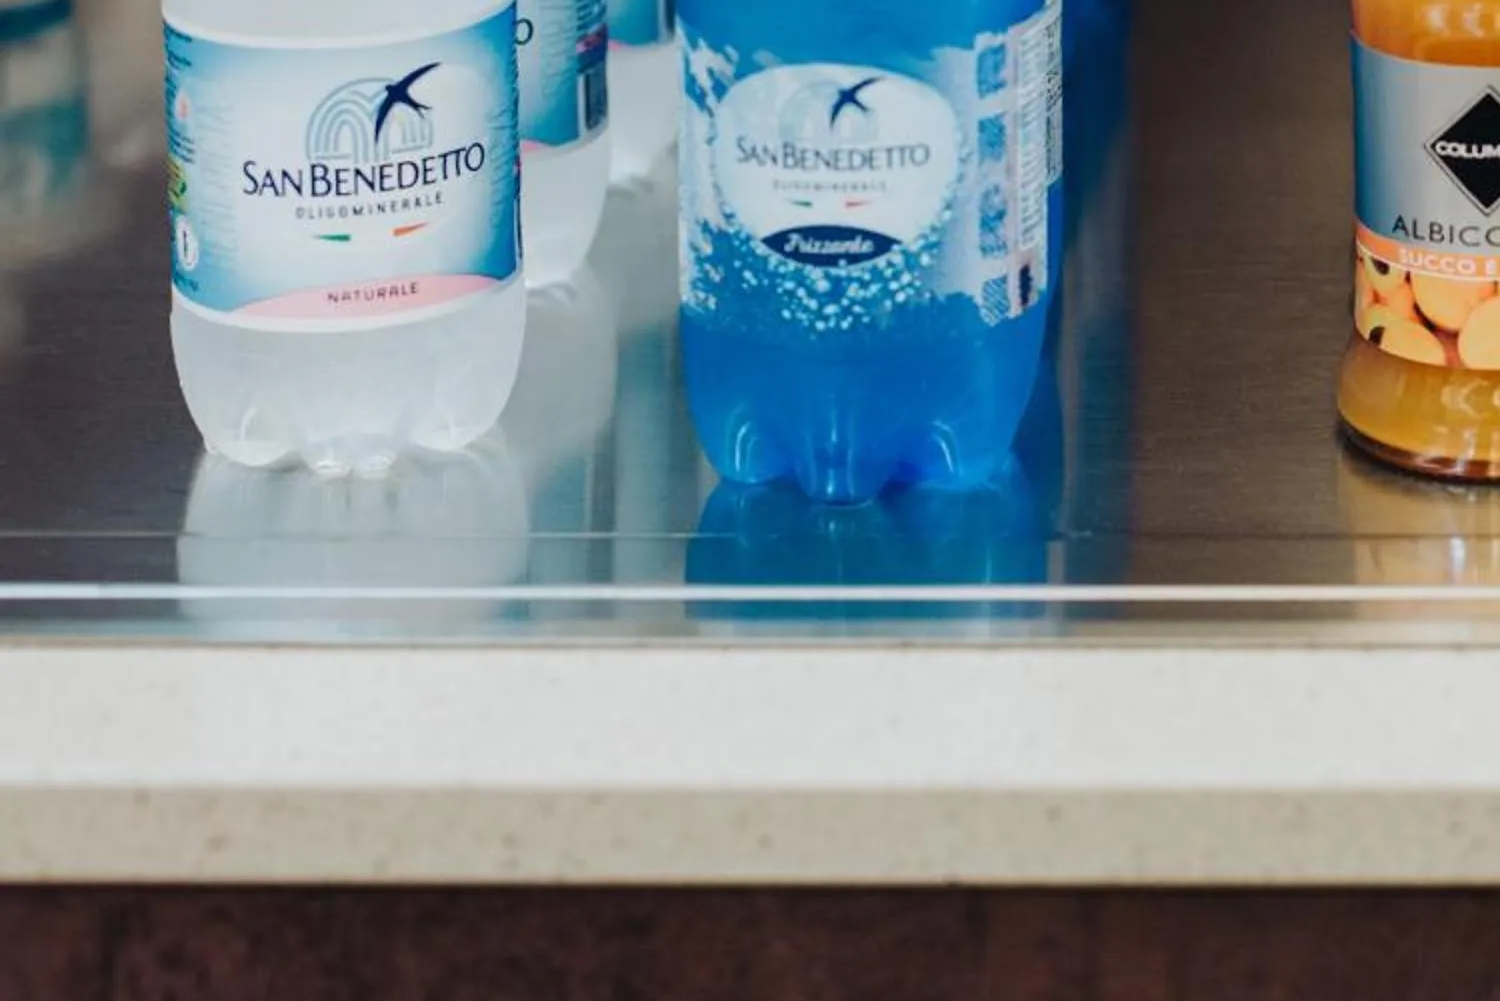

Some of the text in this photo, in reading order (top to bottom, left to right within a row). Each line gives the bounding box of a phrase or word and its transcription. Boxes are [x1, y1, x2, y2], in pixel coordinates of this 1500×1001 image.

[242, 160, 304, 197] SAN
[310, 142, 486, 198] BENEDETTO
[782, 141, 931, 172] BENEDETTO
[296, 191, 444, 220] OLIGOMINERALE
[1400, 249, 1476, 275] SUCCO
[1485, 261, 1497, 275] E
[328, 282, 419, 303] NATURALE
